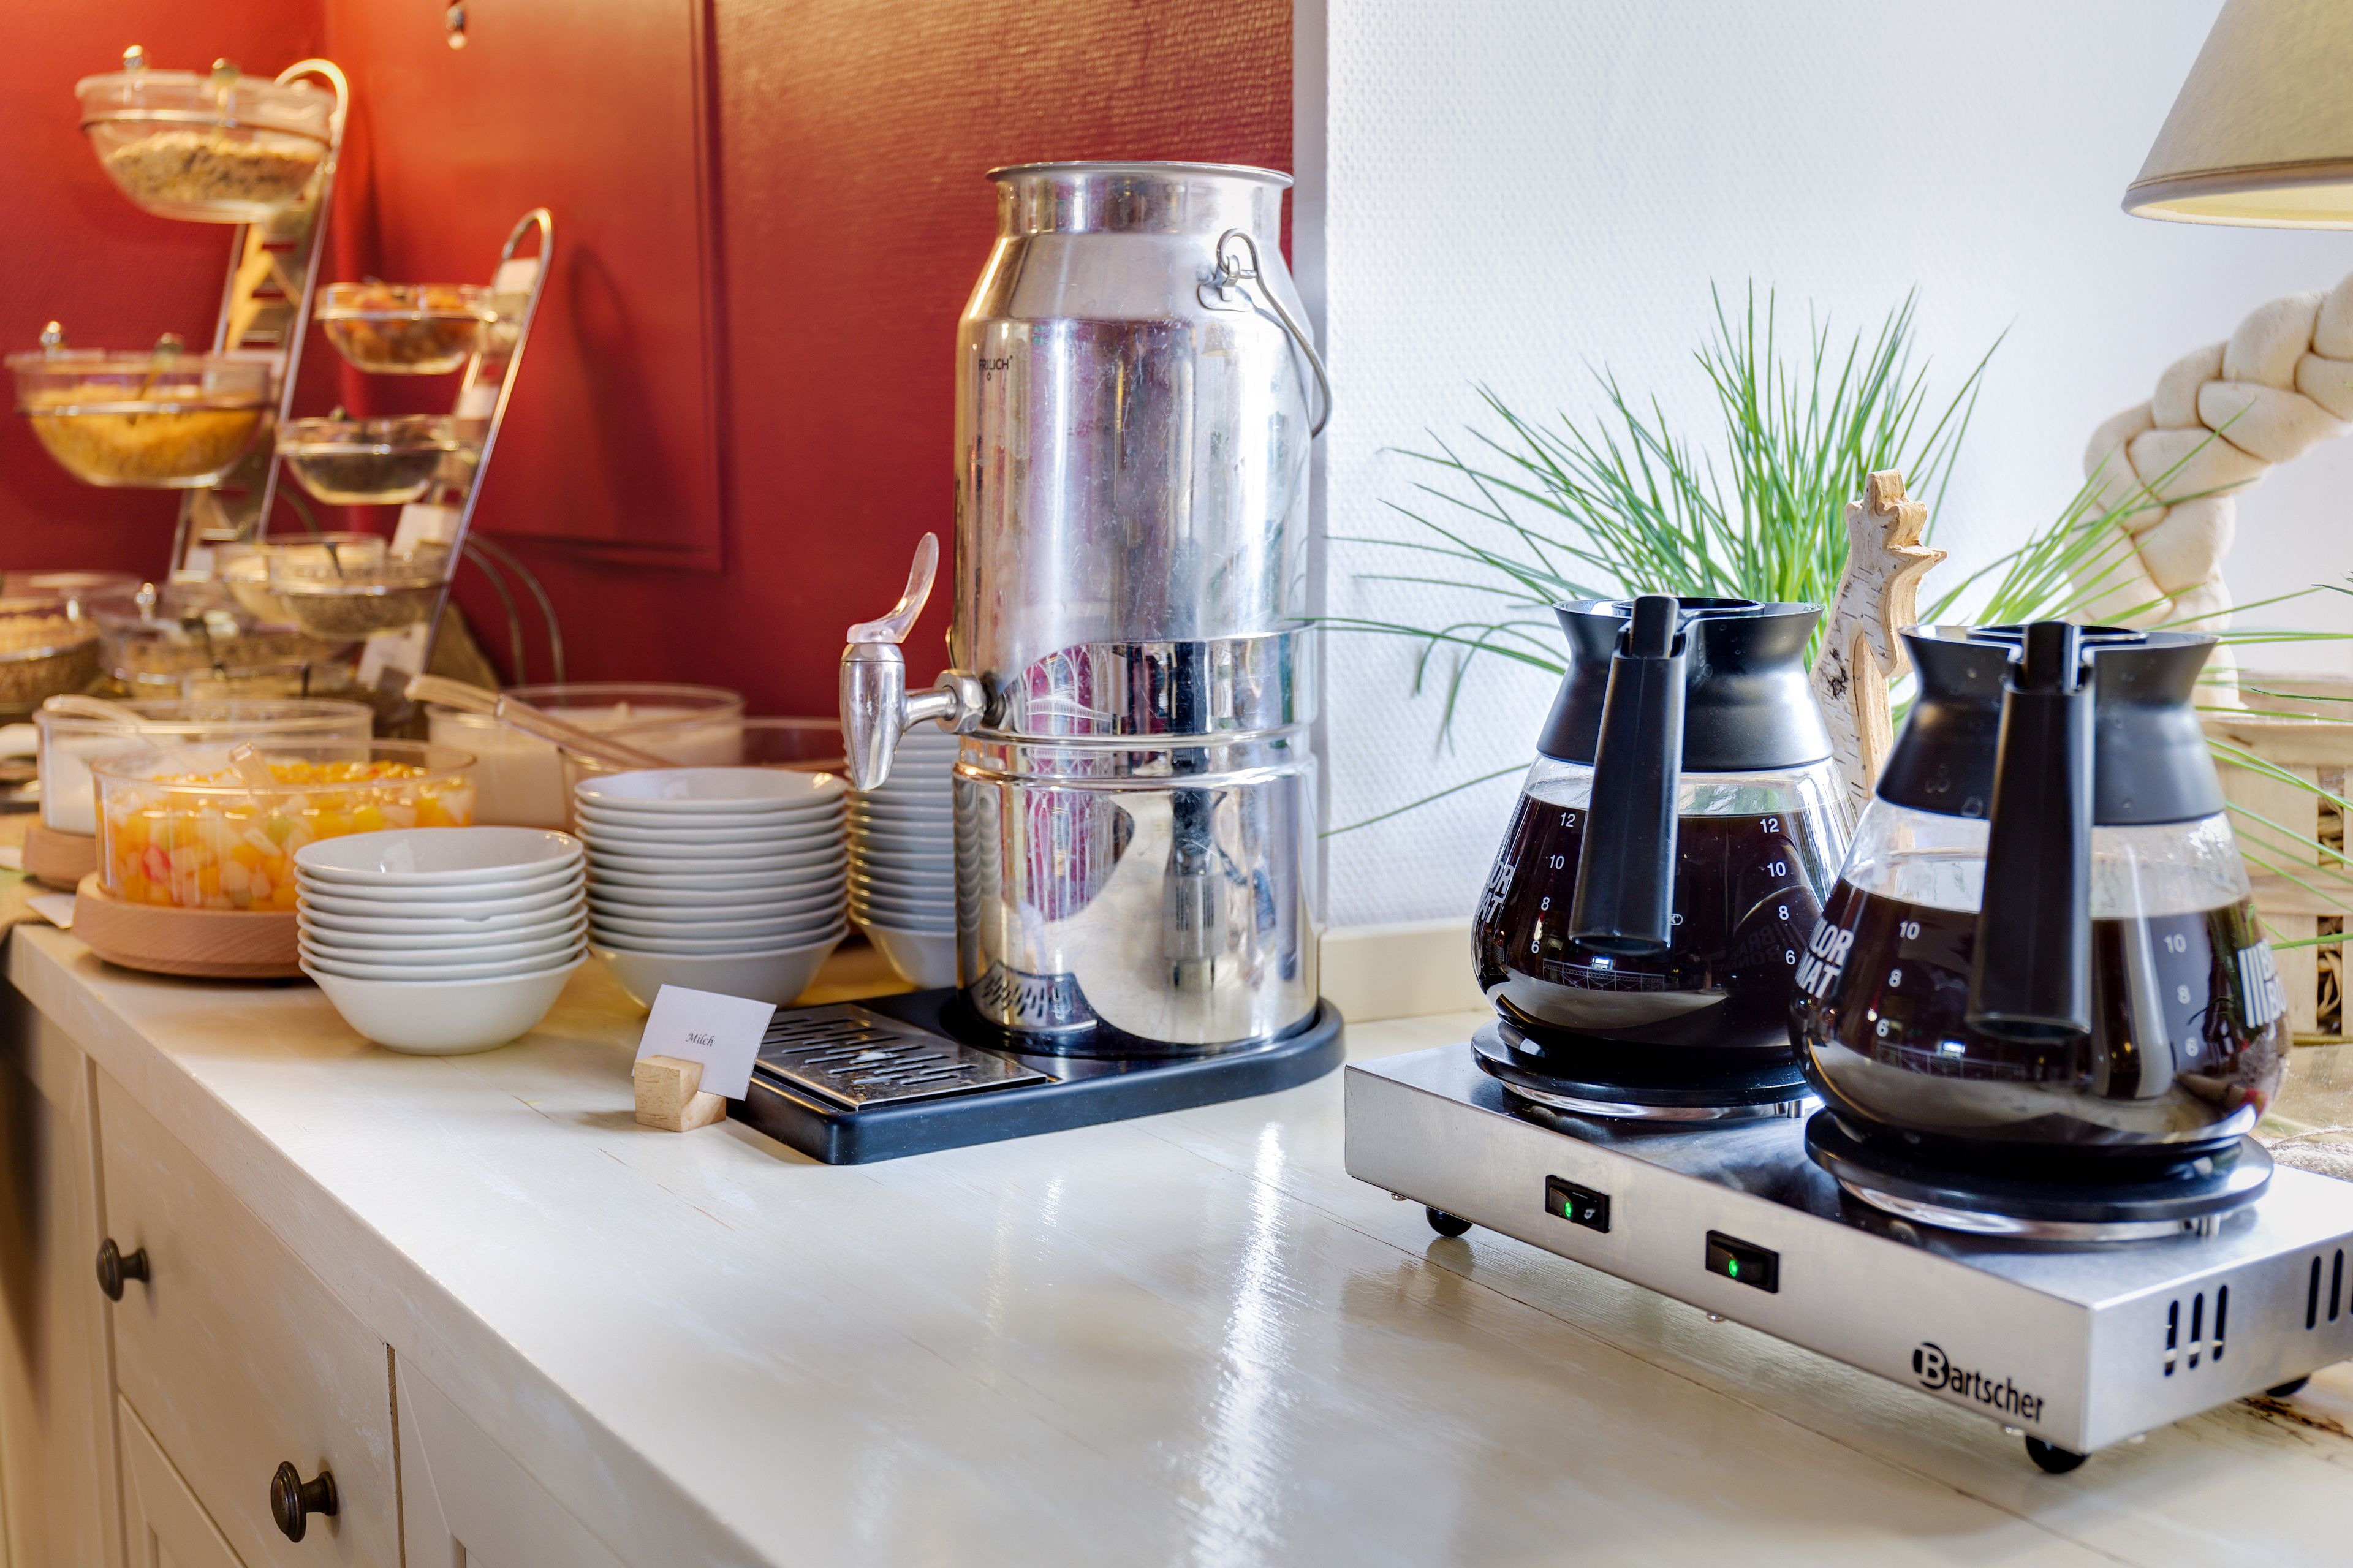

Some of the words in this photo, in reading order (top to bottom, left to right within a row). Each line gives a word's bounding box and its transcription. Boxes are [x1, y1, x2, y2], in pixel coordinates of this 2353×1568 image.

[1560, 812, 1576, 827] 12
[1760, 818, 1780, 833] 12
[1550, 854, 1564, 870] 10
[1767, 862, 1786, 877] 10
[1540, 896, 1550, 911] 8
[1778, 905, 1789, 920] 8
[1900, 920, 1920, 940] 10
[1531, 939, 1540, 954] 6
[2164, 934, 2187, 953] 10
[1785, 950, 1796, 965] 6
[1889, 969, 1902, 988] 8
[2177, 985, 2191, 1004] 8
[1876, 1018, 1890, 1037] 6
[685, 1032, 715, 1047] Milch
[2185, 1037, 2199, 1057] 6
[1912, 1343, 2045, 1422] Bartscher
